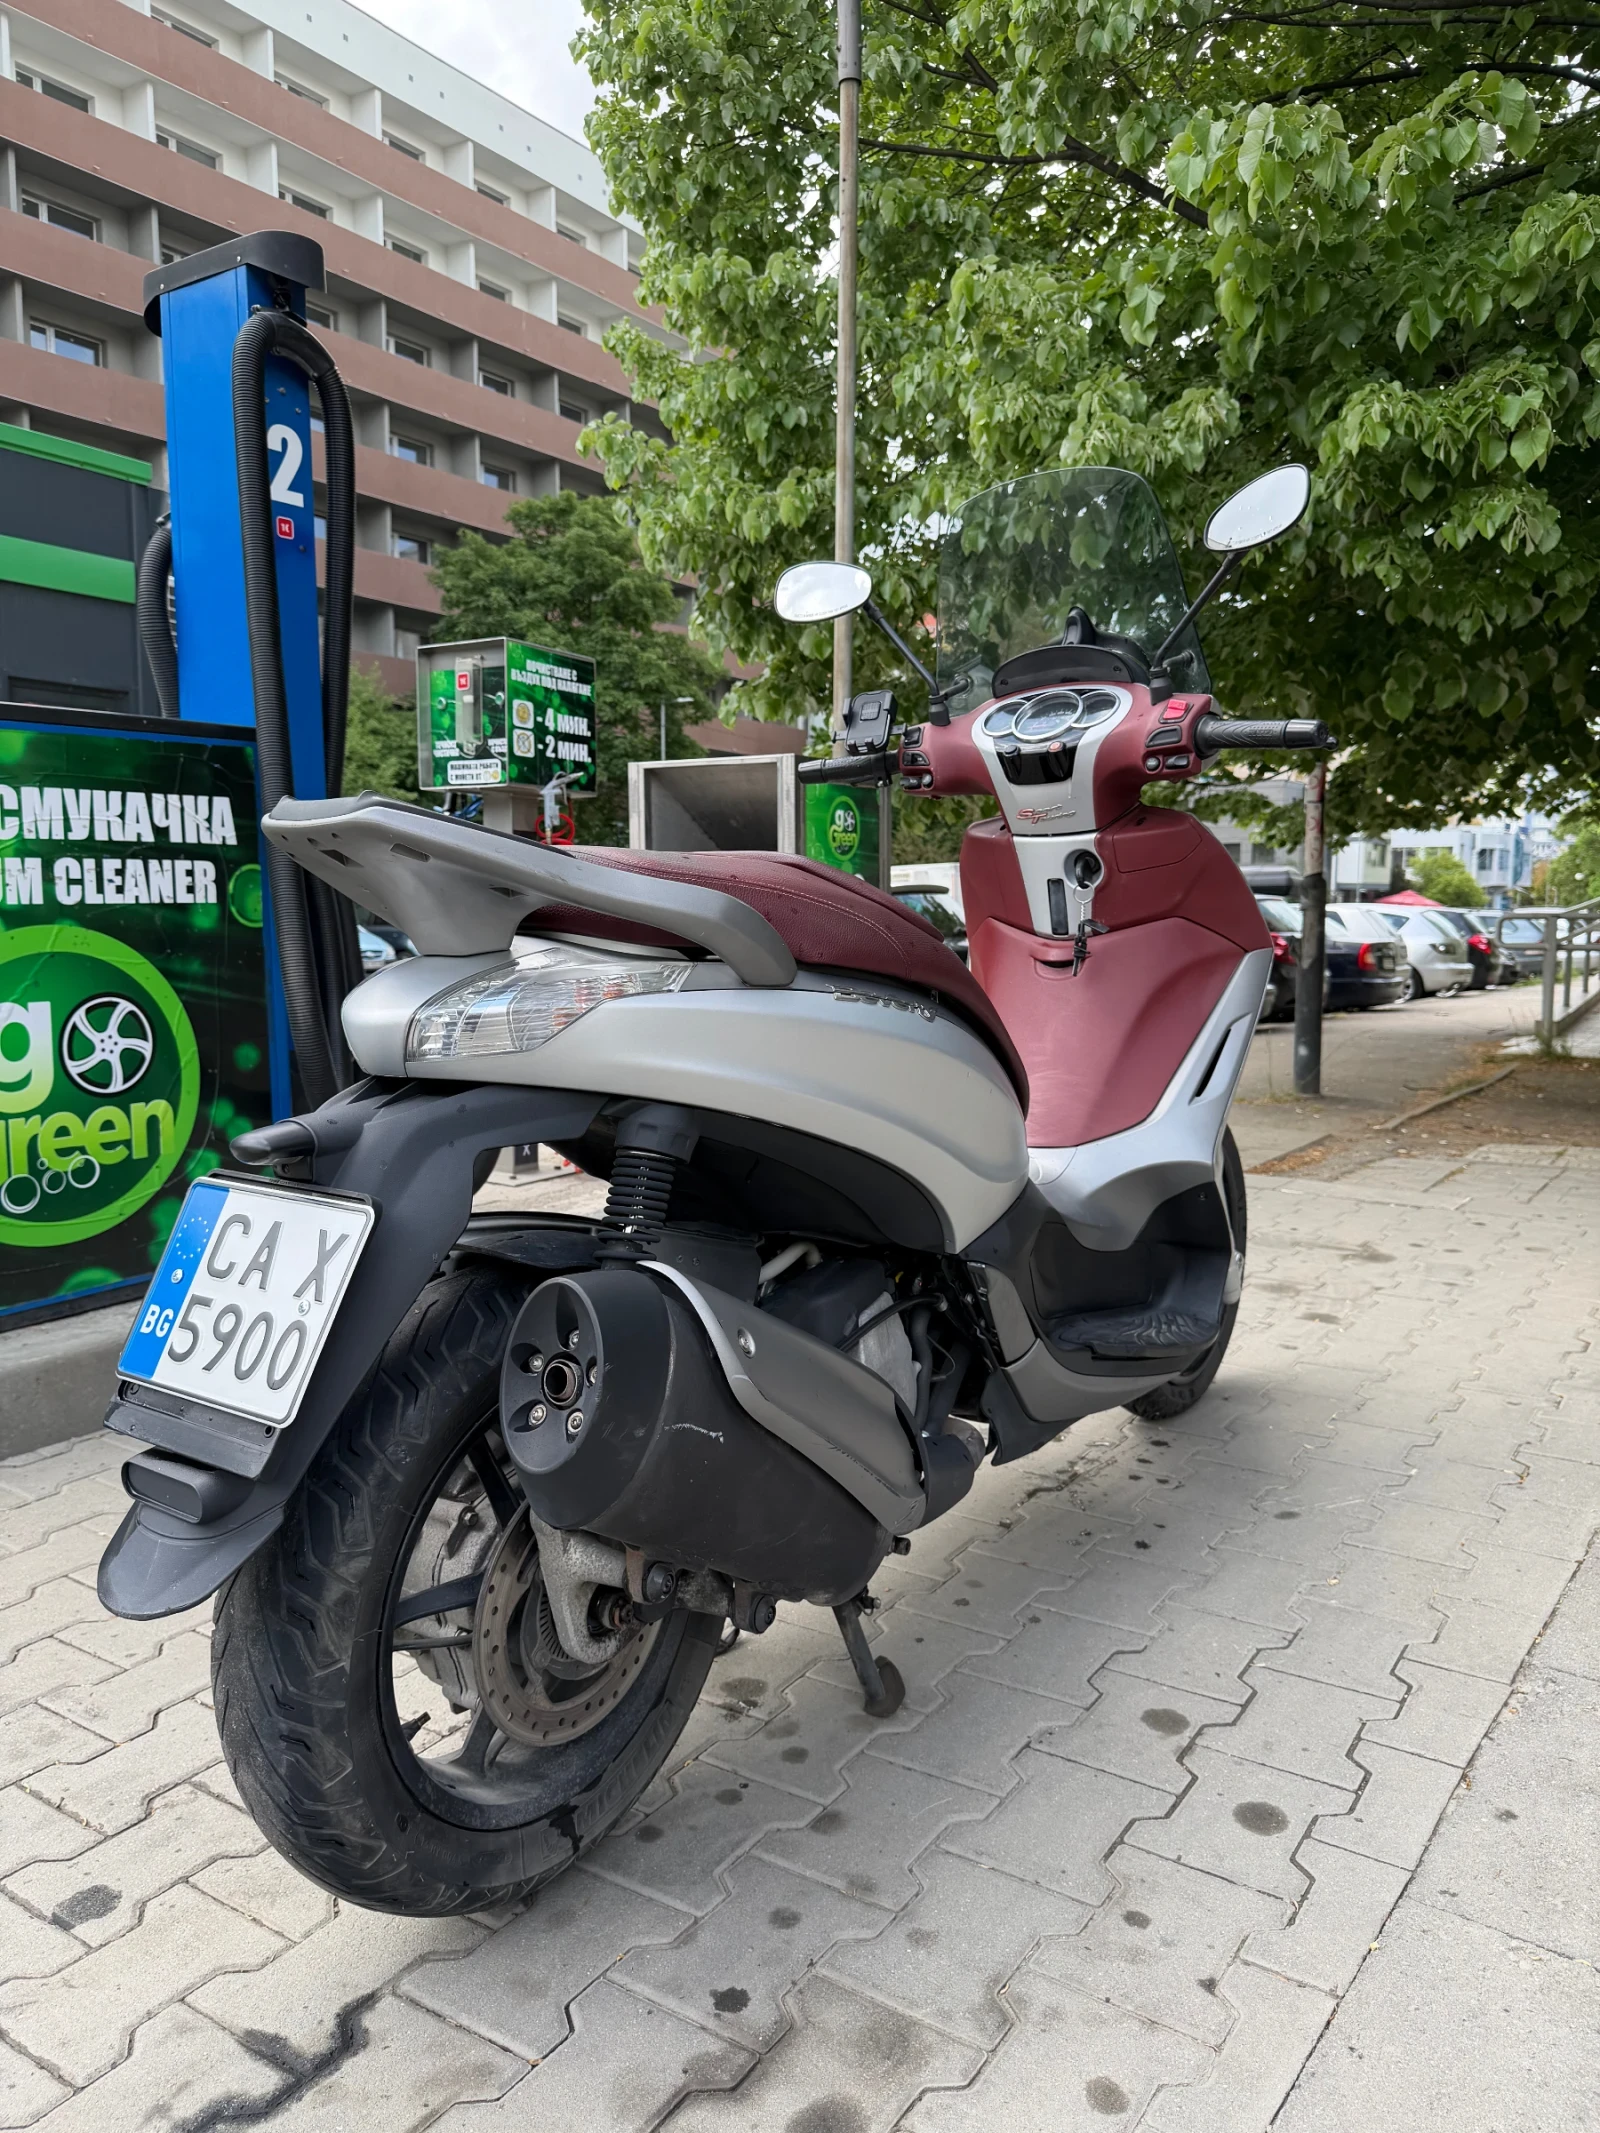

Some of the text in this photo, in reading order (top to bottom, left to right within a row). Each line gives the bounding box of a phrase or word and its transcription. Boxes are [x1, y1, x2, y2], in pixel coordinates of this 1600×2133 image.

[267, 424, 304, 508] 2
[544, 708, 555, 731] 4
[545, 735, 556, 758] 2
[557, 741, 592, 763] МИН.
[53, 857, 217, 906] CLEANER
[0, 1099, 175, 1184] reen
[206, 1213, 350, 1303] CA X
[139, 1304, 175, 1339] BG
[167, 1293, 309, 1392] 5900
